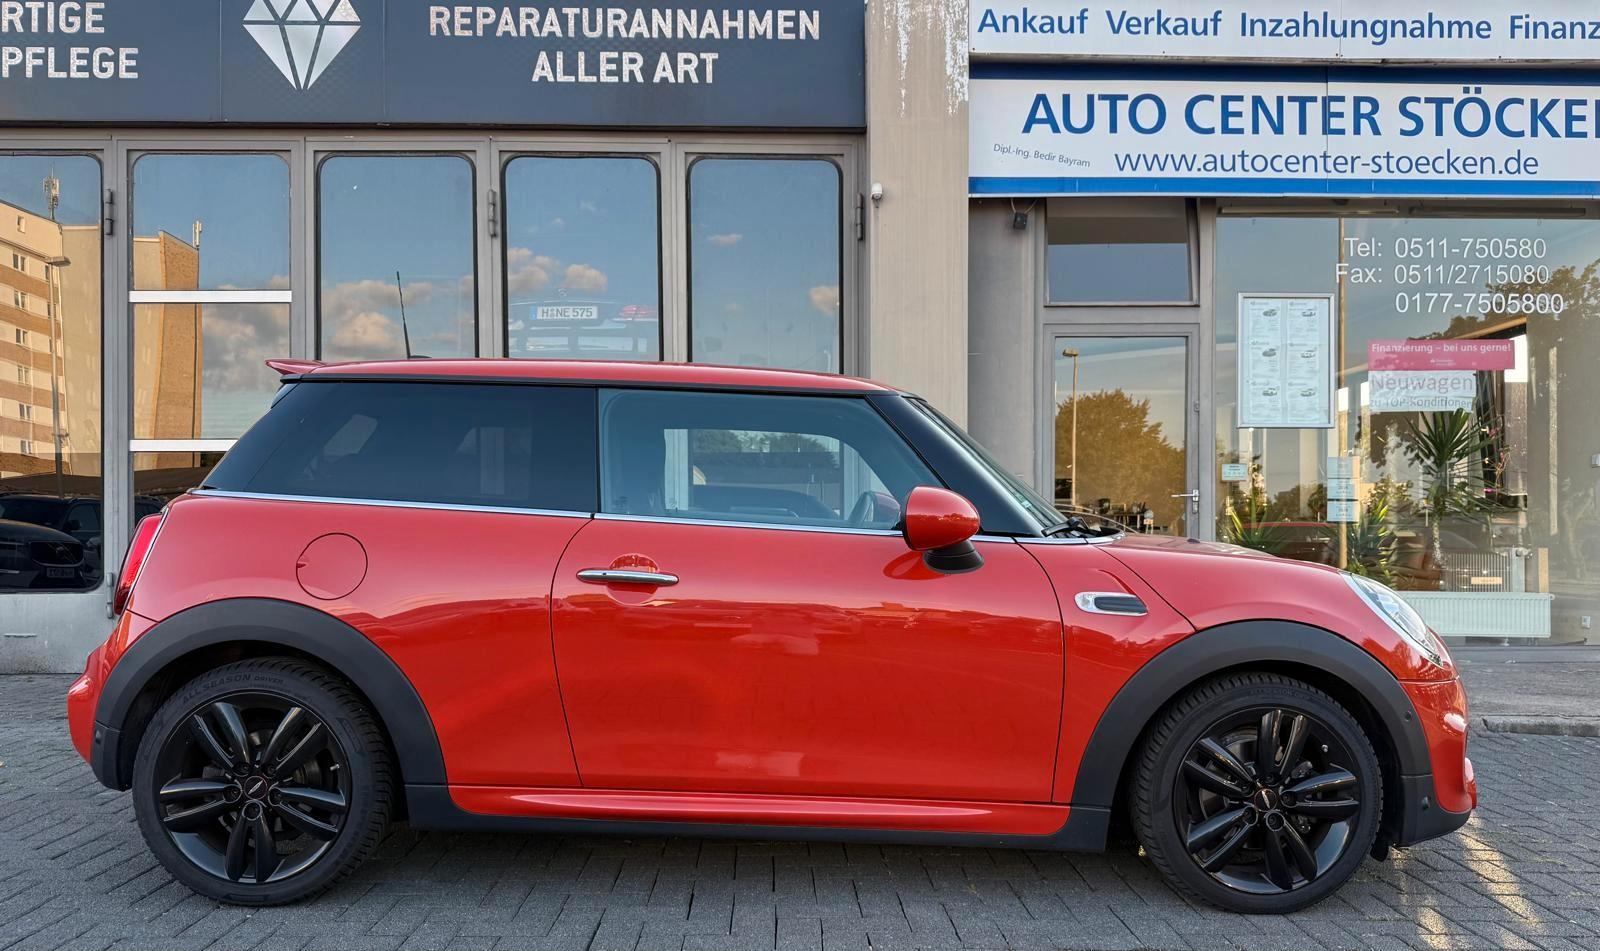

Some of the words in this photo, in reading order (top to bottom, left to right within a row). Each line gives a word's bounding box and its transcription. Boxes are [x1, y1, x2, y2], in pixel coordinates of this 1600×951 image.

[1, 1, 106, 34] RTIGE
[429, 5, 820, 41] REPARATURANNAHMEN
[977, 7, 1089, 34] Ankauf
[1105, 9, 1223, 37] Verkauf
[1240, 11, 1492, 46] Inzahlungnahme
[1509, 14, 1600, 40] Finanz
[1, 46, 139, 79] PFLEGE
[531, 50, 645, 83] ALLER
[652, 51, 719, 84] ART
[1021, 93, 1167, 135] AUTO
[1184, 94, 1382, 137] CENTER
[1398, 86, 1600, 139] STÖCKE
[993, 143, 1032, 159] Dipl.-Ing.
[1033, 150, 1057, 162] Bedir
[1058, 154, 1091, 168] Bayram
[1114, 148, 1539, 176] www.autocenter-stoecken.de
[1343, 237, 1383, 257] Tel:
[1394, 237, 1547, 259] 0511-750580
[1335, 263, 1383, 284] Fax:
[1394, 264, 1549, 285] 0511/2715080
[572, 307, 593, 318] 575
[1395, 292, 1565, 315] 0177-7505800
[1371, 343, 1434, 354] Finanzierung
[1443, 343, 1459, 352] bei
[1460, 344, 1478, 352] uns
[1479, 343, 1512, 354] gerne!
[1371, 374, 1473, 394] Neuwagen
